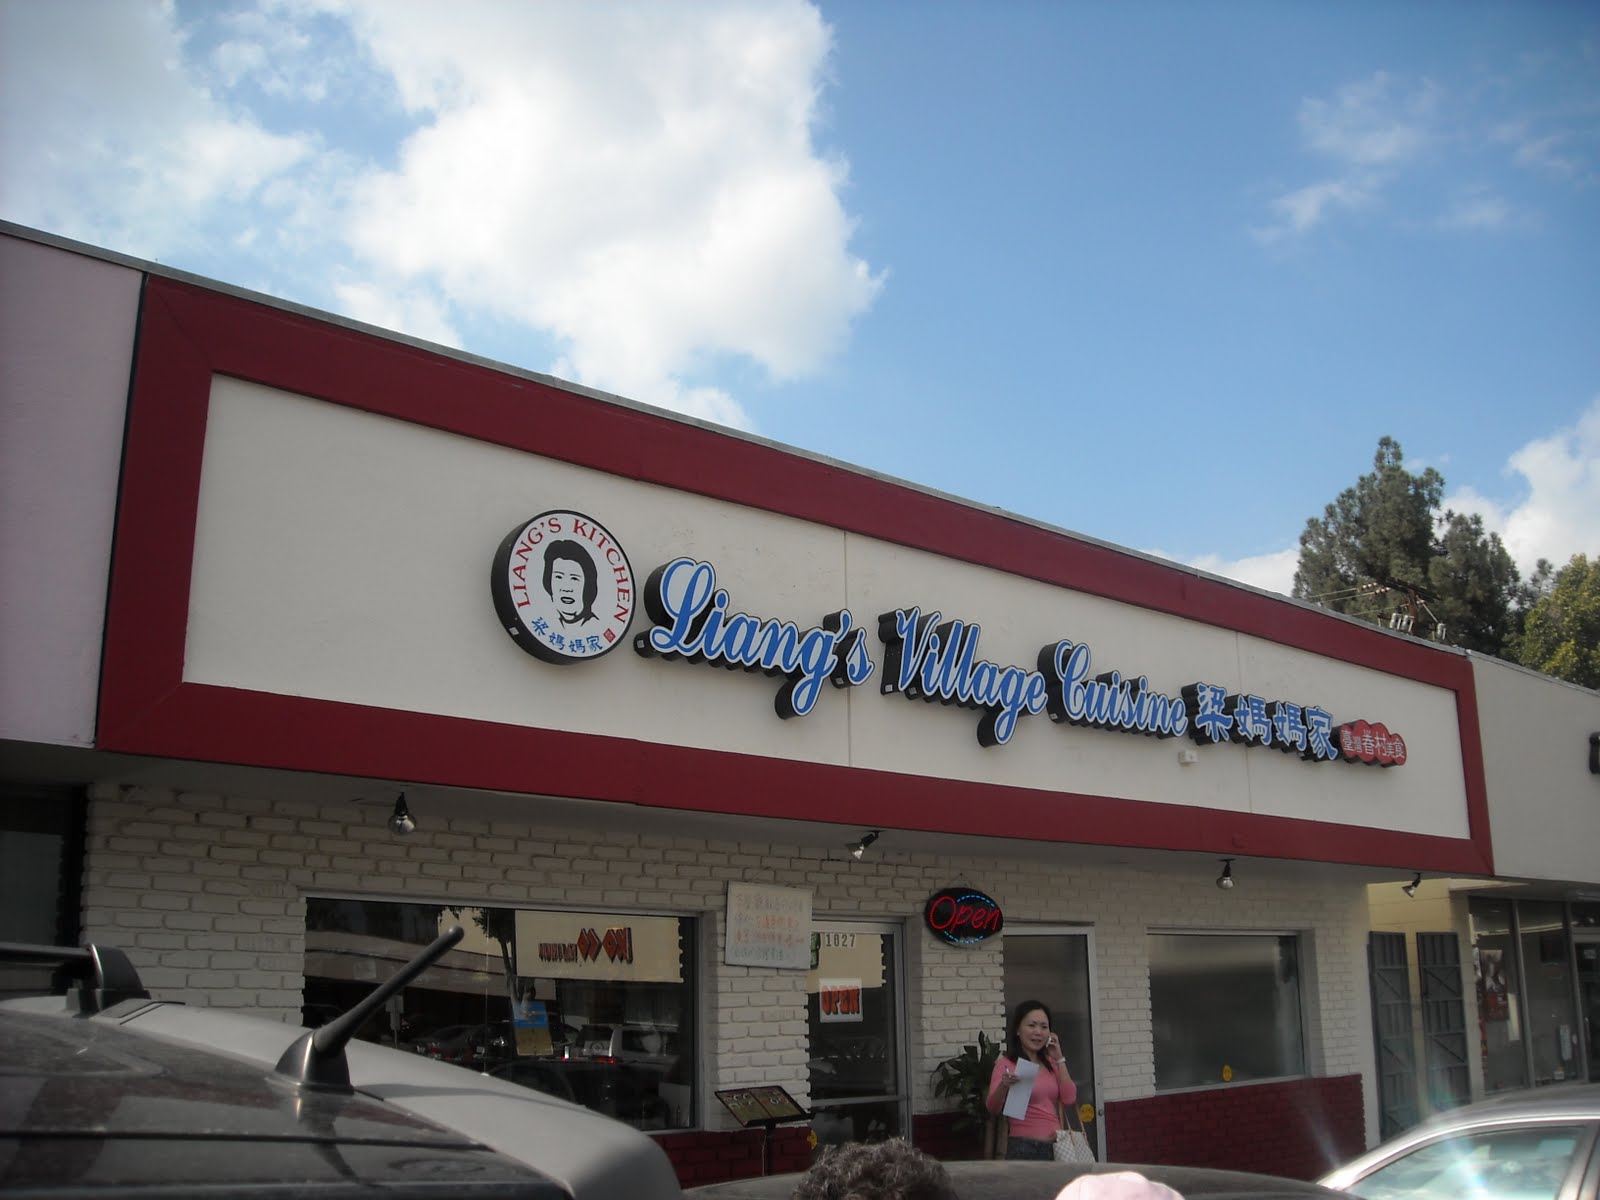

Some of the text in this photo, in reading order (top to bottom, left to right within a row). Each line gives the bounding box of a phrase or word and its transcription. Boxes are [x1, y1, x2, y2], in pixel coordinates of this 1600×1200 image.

[512, 517, 630, 623] LIANG'S KITCHEN
[531, 617, 604, 654] 梁媽媽家
[649, 557, 1189, 745] Liang's Village Cuisine
[1195, 682, 1339, 761] 梁媽媽家
[930, 896, 1001, 934] Open
[825, 934, 856, 948] 1027
[821, 985, 861, 1016] OPEN
